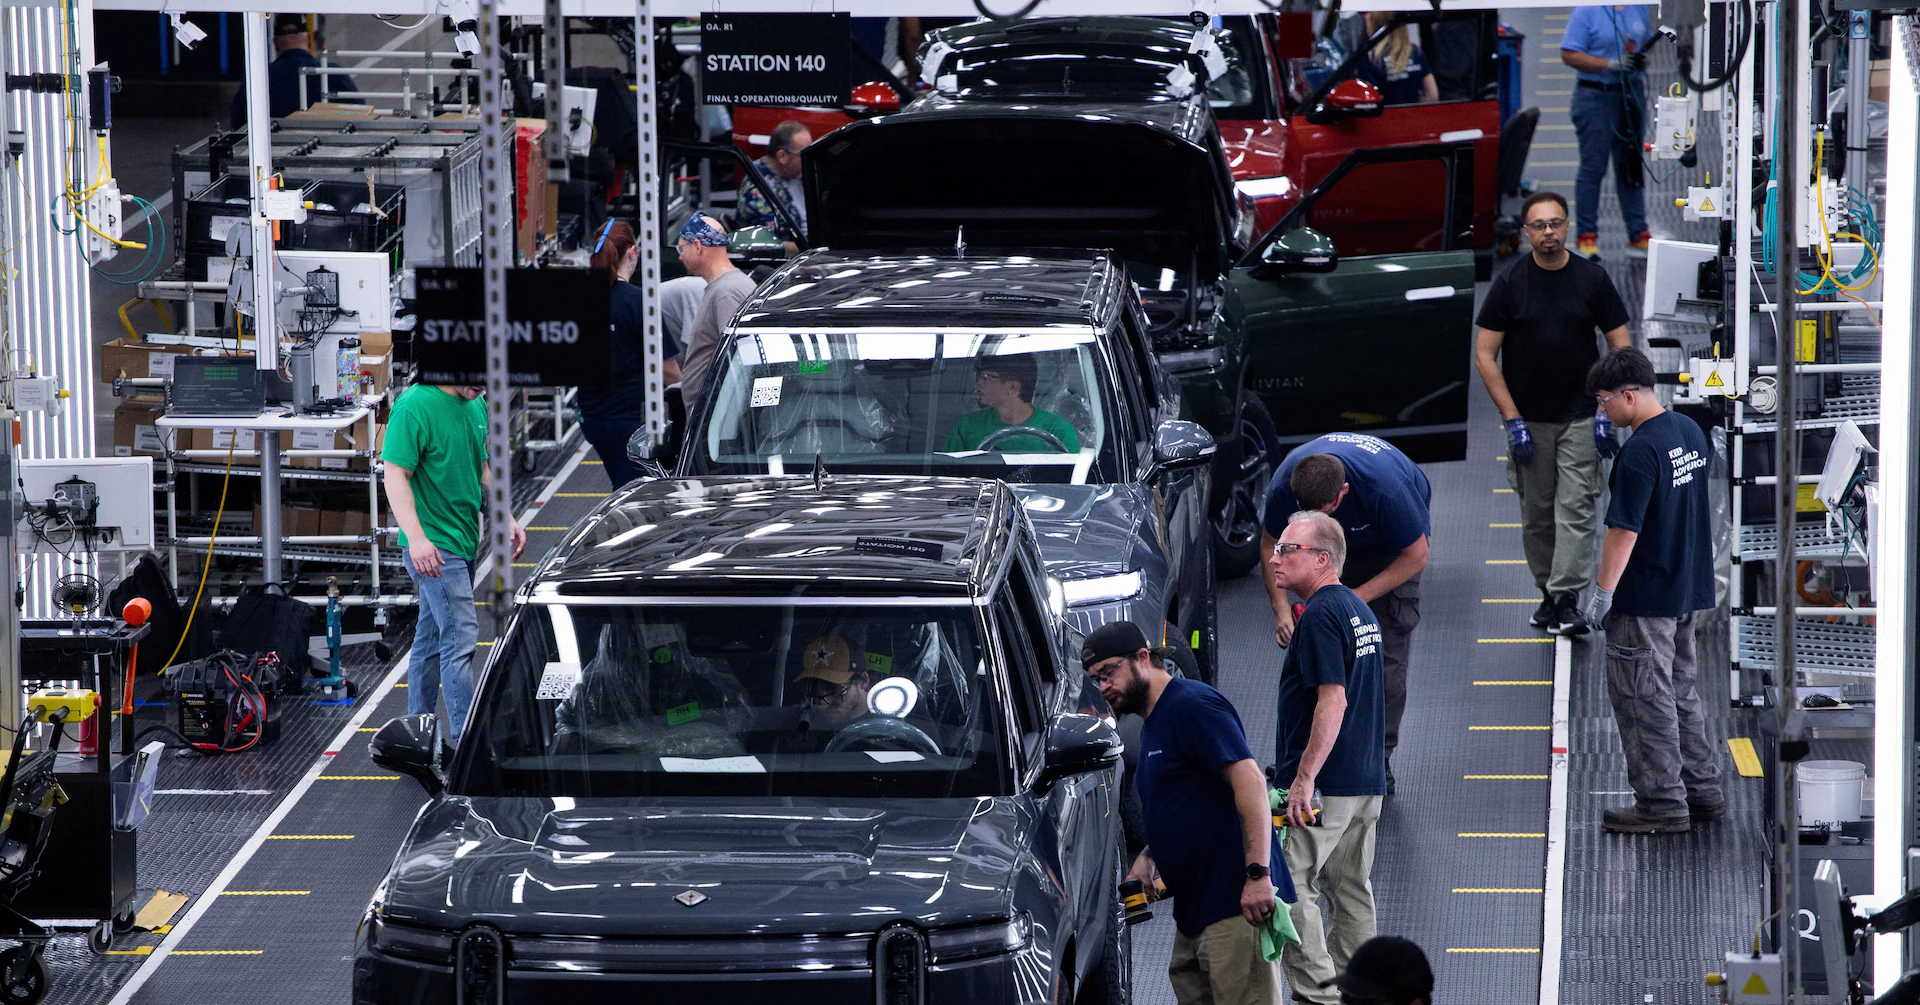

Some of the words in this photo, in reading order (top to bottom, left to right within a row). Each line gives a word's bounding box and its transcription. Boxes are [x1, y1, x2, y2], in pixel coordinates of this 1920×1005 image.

[705, 23, 722, 31] GA.
[724, 23, 733, 31] R1
[706, 54, 790, 72] STATION
[795, 54, 826, 72] 140
[707, 95, 731, 104] FINAL
[734, 95, 739, 103] 2
[741, 95, 838, 104] OPERATIONS/QUALITY
[1313, 208, 1355, 219] IVIAN
[423, 319, 533, 344] STATN
[536, 320, 580, 345] 150
[468, 372, 541, 384] OPIONS
[1252, 376, 1305, 389] IVIAN
[1668, 447, 1683, 459] KEEP
[1671, 456, 1685, 468] THE
[1683, 451, 1698, 463] WLD
[869, 655, 883, 665] LH
[675, 705, 690, 717] RH
